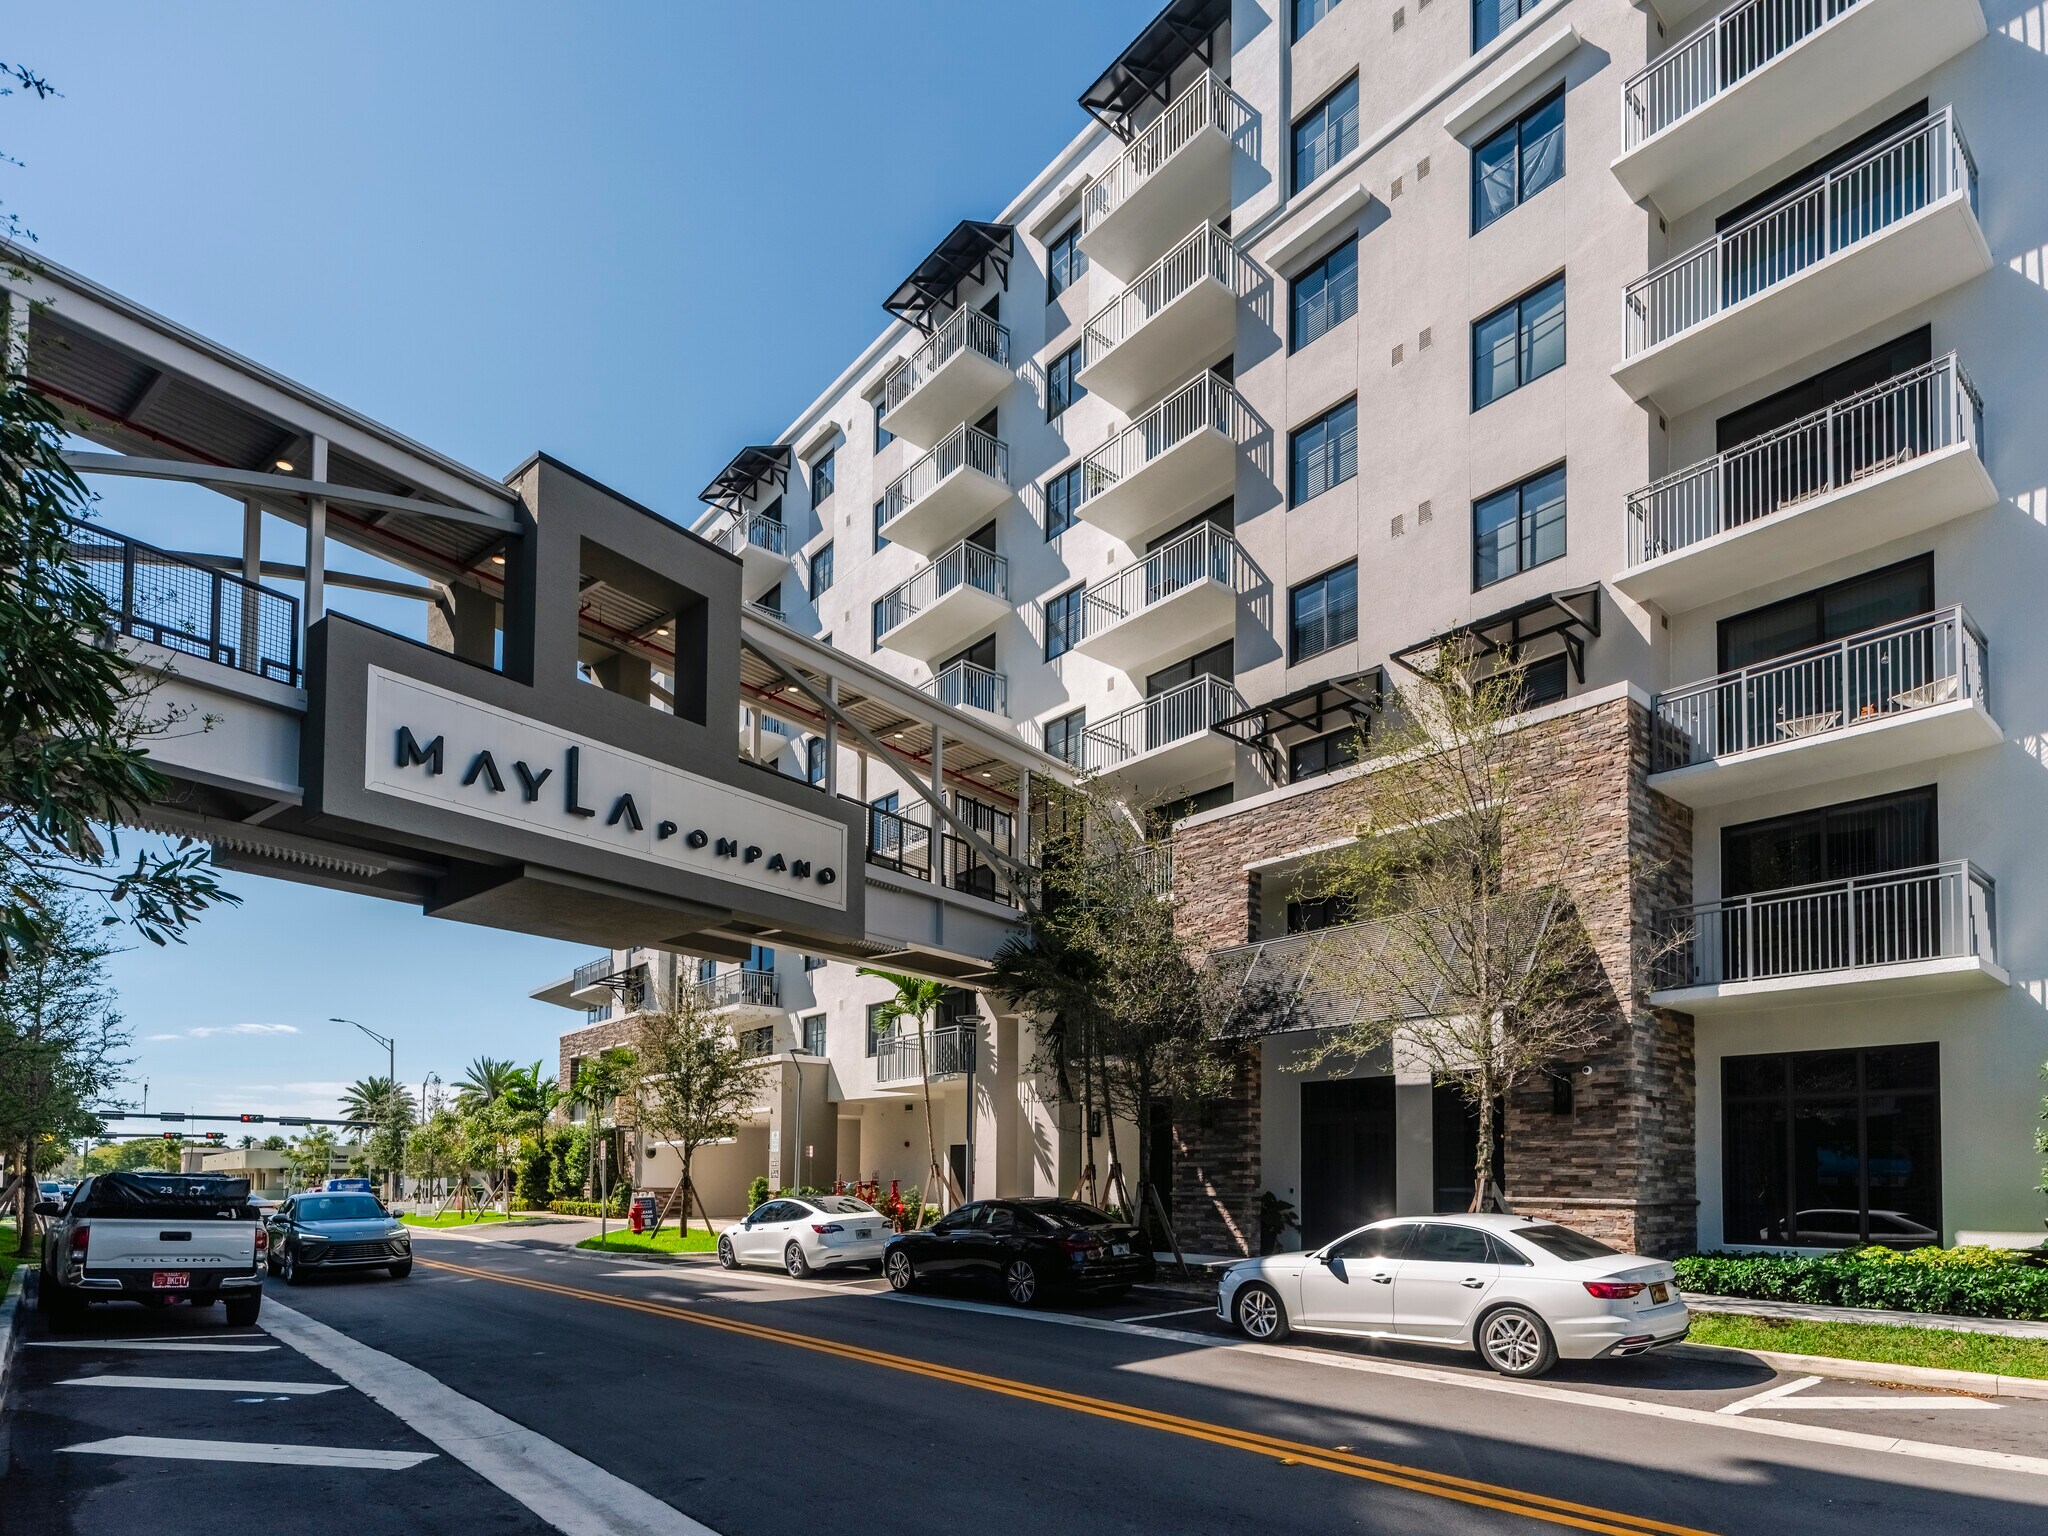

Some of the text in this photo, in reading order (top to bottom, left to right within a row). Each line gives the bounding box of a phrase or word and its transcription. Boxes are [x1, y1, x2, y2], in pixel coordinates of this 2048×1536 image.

[397, 725, 837, 885] MAYLA POMPANO
[160, 1186, 173, 1194] 23
